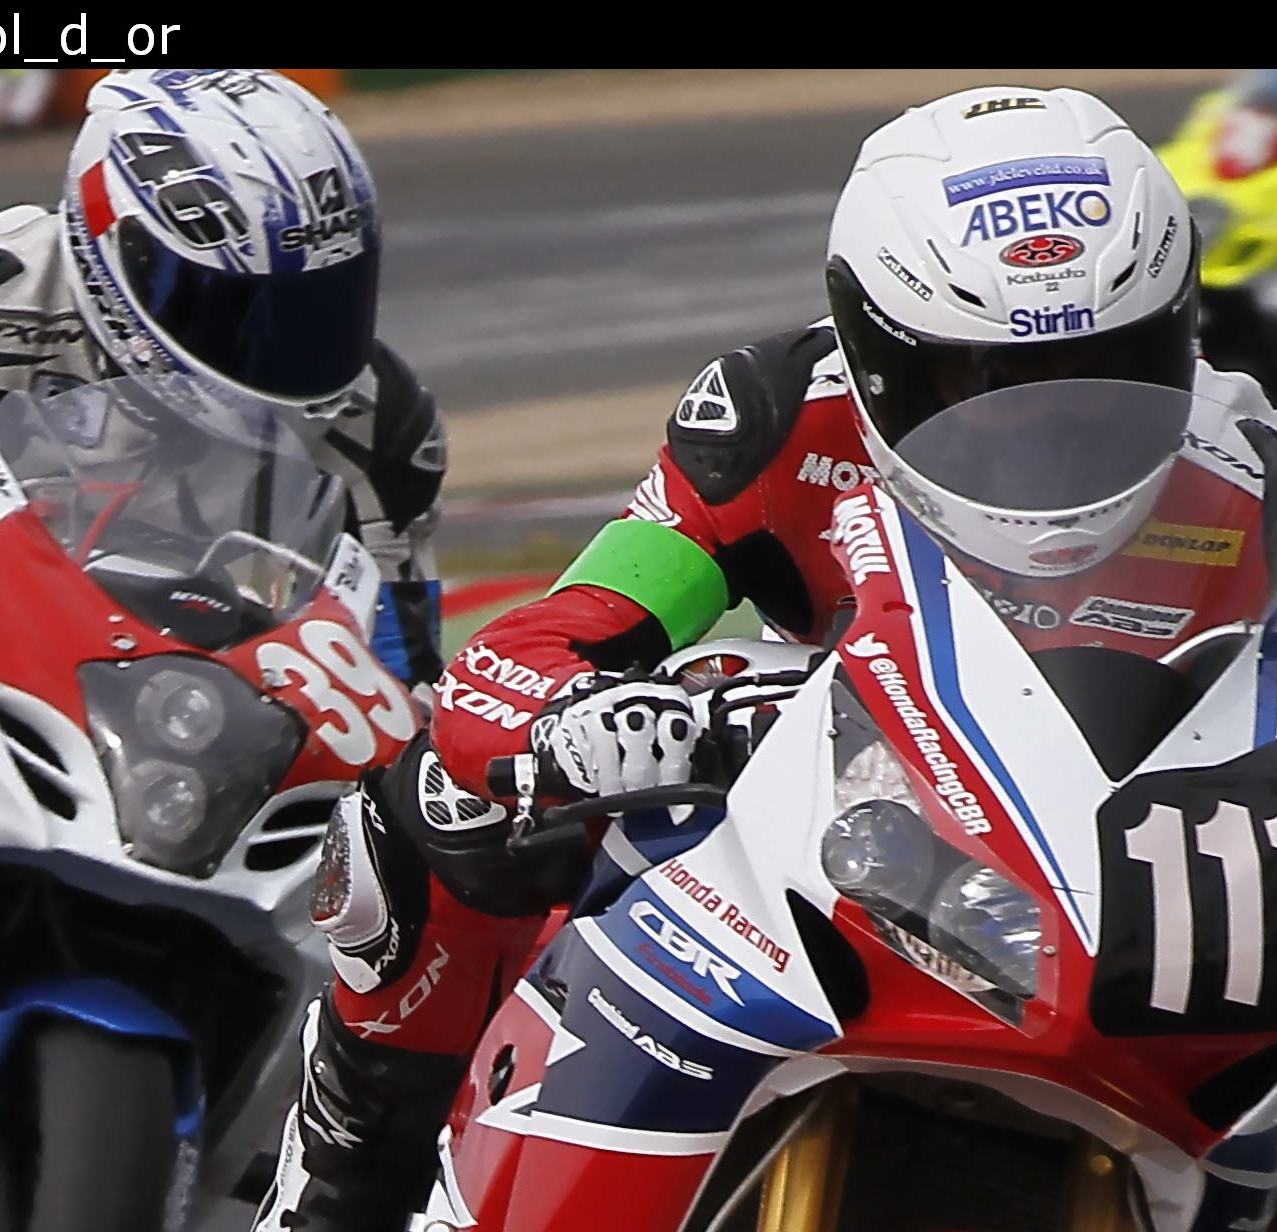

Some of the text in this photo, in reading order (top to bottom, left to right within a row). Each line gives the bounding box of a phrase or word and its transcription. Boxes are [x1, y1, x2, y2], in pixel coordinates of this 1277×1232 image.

[961, 190, 1111, 247] ABEKO
[1006, 268, 1086, 286] Kabuto
[1009, 303, 1096, 338] Stirlin
[796, 451, 882, 492] MOT
[833, 494, 892, 586] MOTUL
[256, 619, 416, 766] 39
[868, 657, 992, 837] @HondaRacingCBR
[628, 899, 746, 1008] CBR
[659, 857, 792, 975] Honda Racing
